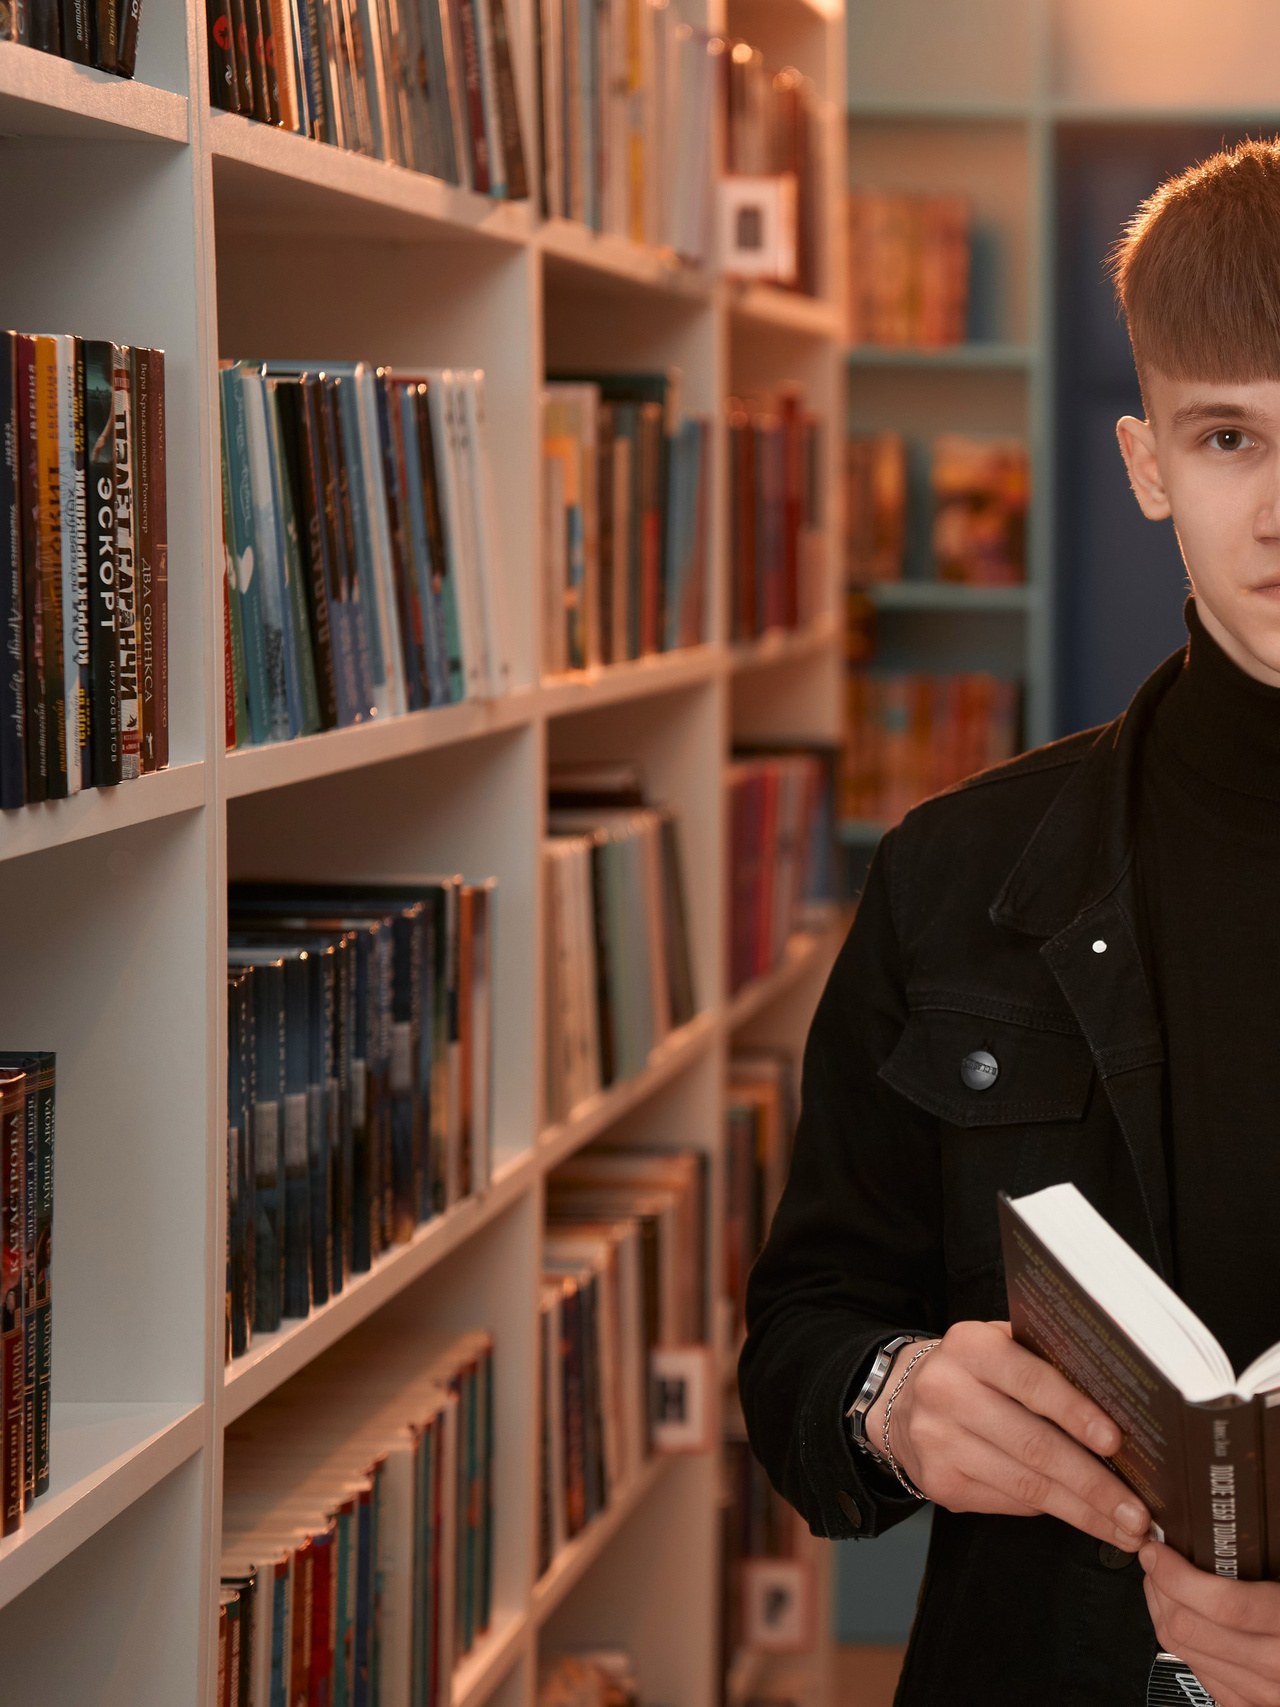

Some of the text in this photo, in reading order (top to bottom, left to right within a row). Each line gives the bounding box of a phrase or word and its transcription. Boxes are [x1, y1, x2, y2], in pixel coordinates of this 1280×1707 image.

[28, 364, 38, 440] ЕВГЕНИЯ
[140, 363, 151, 535] Вера Крыжановская-Рочестер
[75, 469, 89, 665] КОРРЕКТИРОВЩИК
[97, 476, 116, 632] ЭСКОРТ
[117, 547, 137, 700] САРАНЧИ
[141, 557, 154, 703] ДВА СФИНКСА
[109, 660, 118, 763] КРУГОСВЕТОВ
[9, 1115, 19, 1273] КАТАСТРОФА
[42, 1098, 52, 1211] ТАЙНЫ ДВОРА
[8, 1340, 23, 1420] ЛАВРОВ
[1210, 1464, 1238, 1580] ПОСЛЕ ТЕБЯ ТОЛЬКО ПЕП
